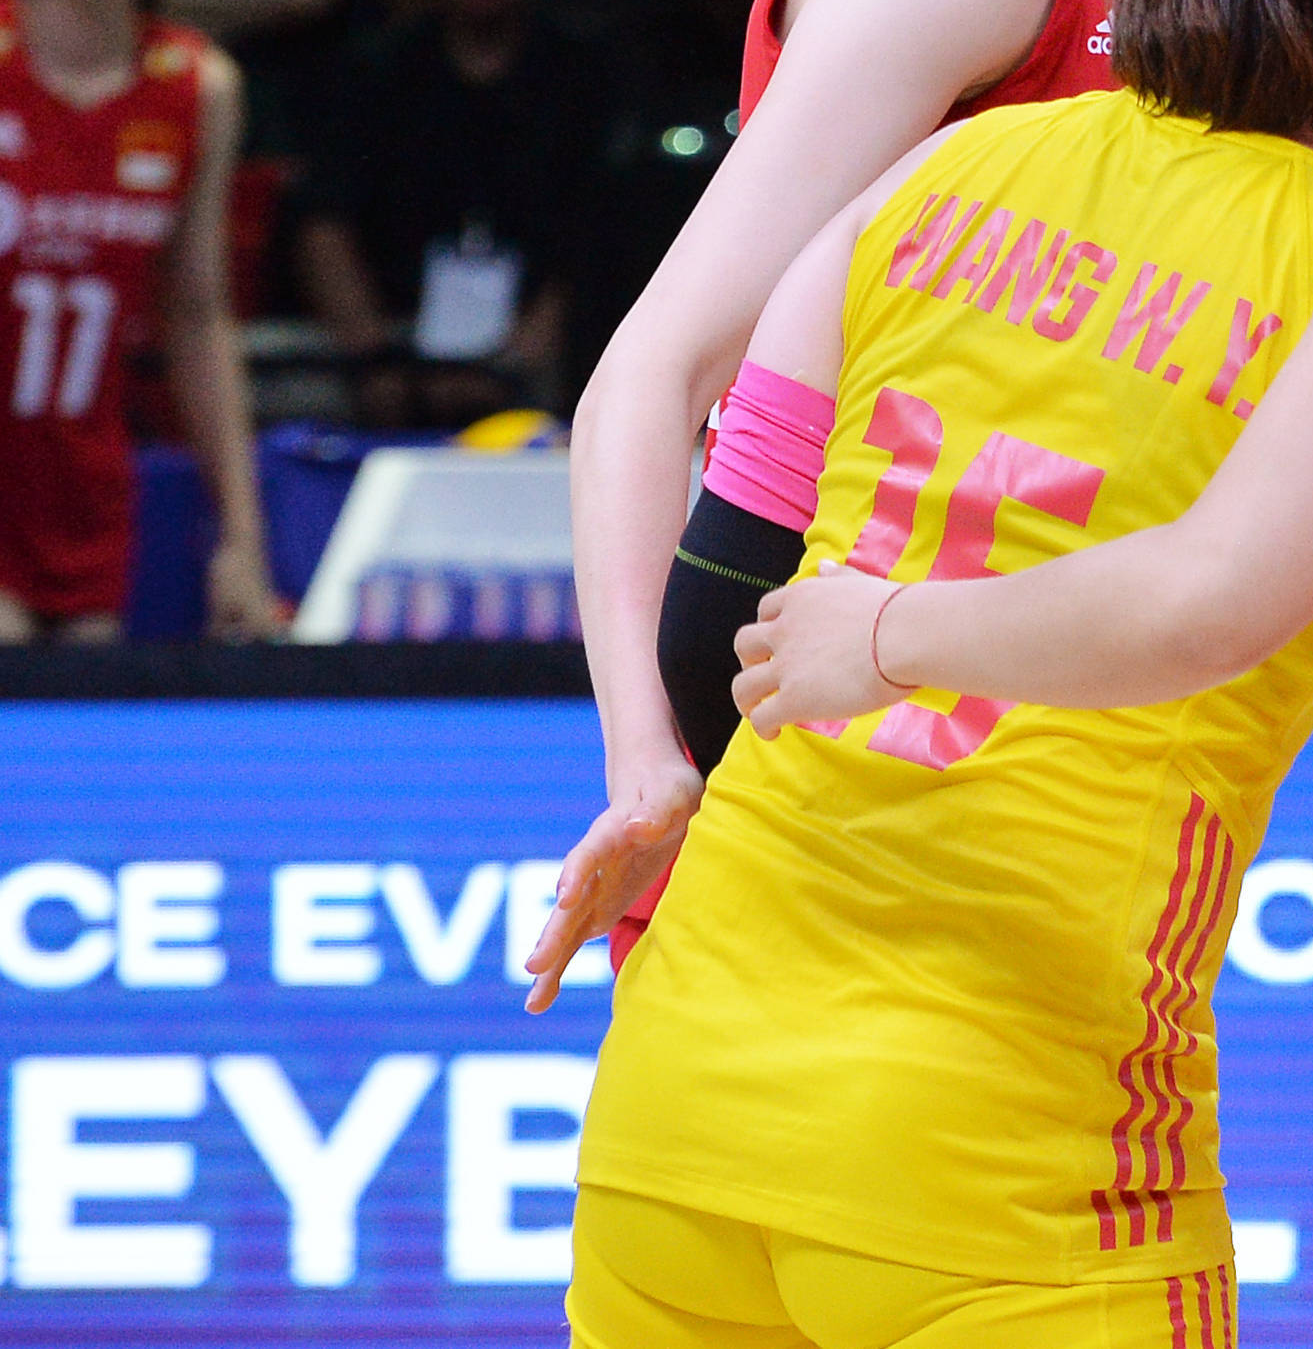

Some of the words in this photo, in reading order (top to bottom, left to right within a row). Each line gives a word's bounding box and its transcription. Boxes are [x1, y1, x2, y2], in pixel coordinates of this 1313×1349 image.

[10, 272, 116, 417] 11
[885, 193, 1119, 343] WANG
[1100, 261, 1213, 385] W.
[1205, 297, 1283, 421] Y.
[797, 386, 1107, 773] 15
[0, 1054, 597, 1288] EYB
